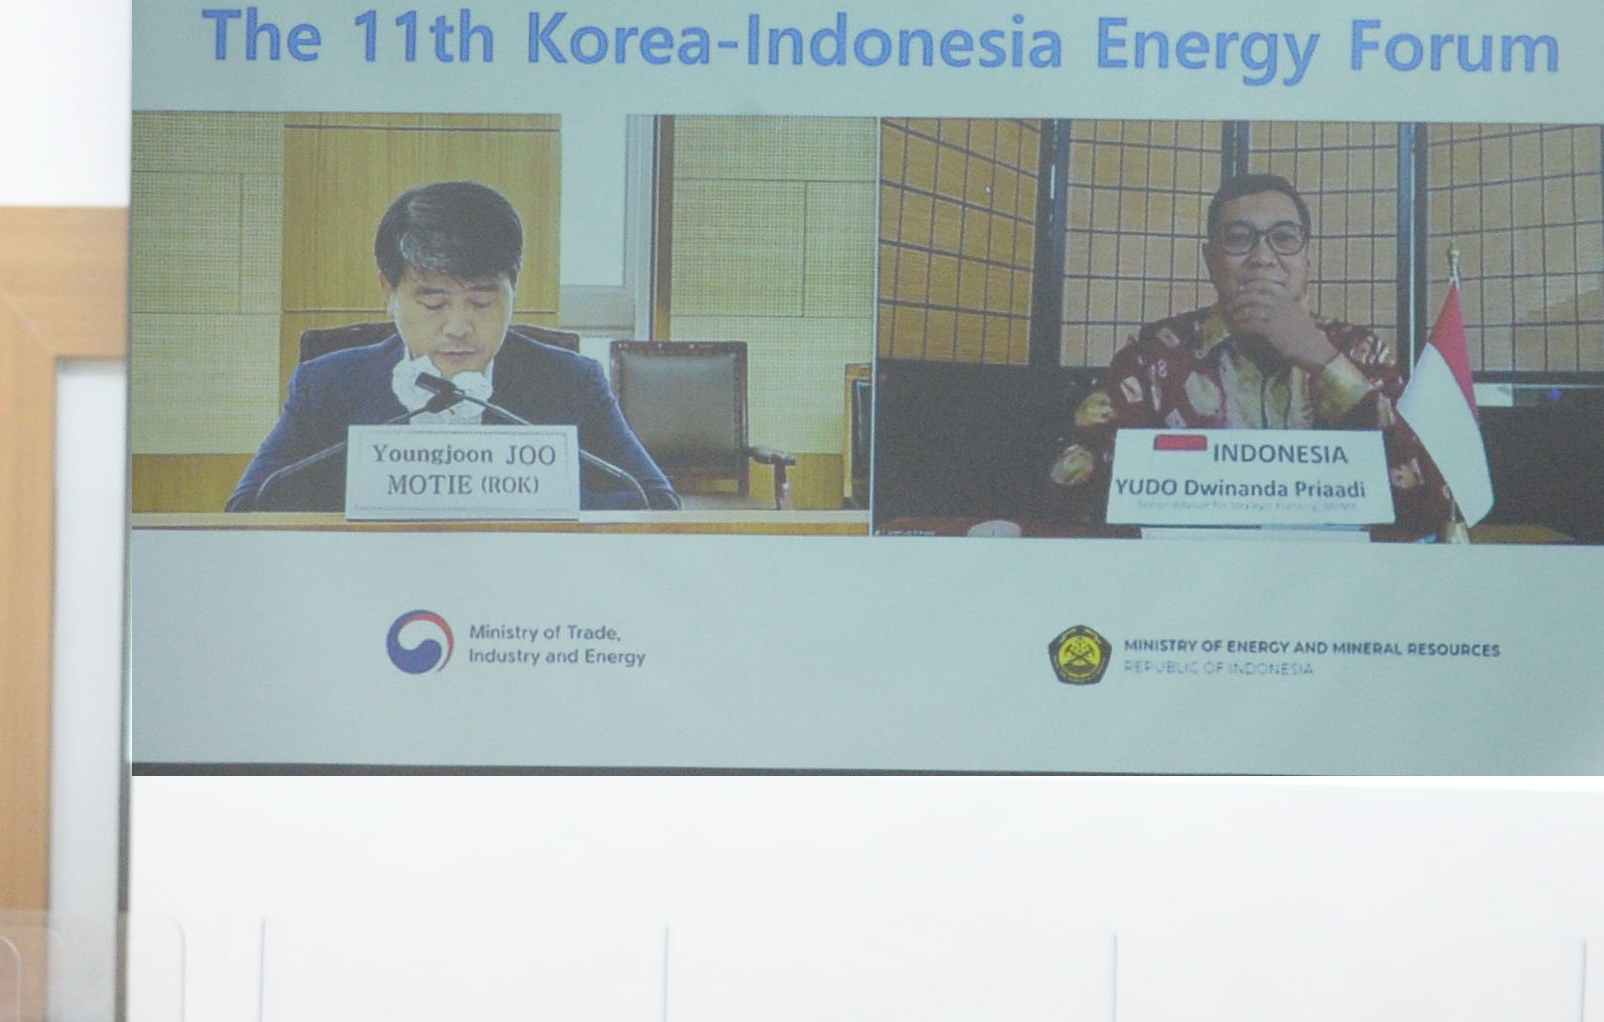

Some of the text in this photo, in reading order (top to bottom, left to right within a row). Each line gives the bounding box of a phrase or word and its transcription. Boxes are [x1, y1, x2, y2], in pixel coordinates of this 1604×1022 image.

[201, 7, 1560, 87] The 11th Korea-Indonesia Energy Forum
[371, 444, 557, 466] Youngjoon JOO
[1212, 443, 1349, 465] INDONESIA
[387, 474, 540, 496] MOTIE (ROK)
[1115, 477, 1367, 499] YUDO Dwinanda Priaadi
[469, 624, 622, 643] Ministry of Trade,
[468, 648, 647, 668] Industry and Energy
[1123, 639, 1502, 658] MINISTRY OF ENERGY AND MINERAL RESOURCES
